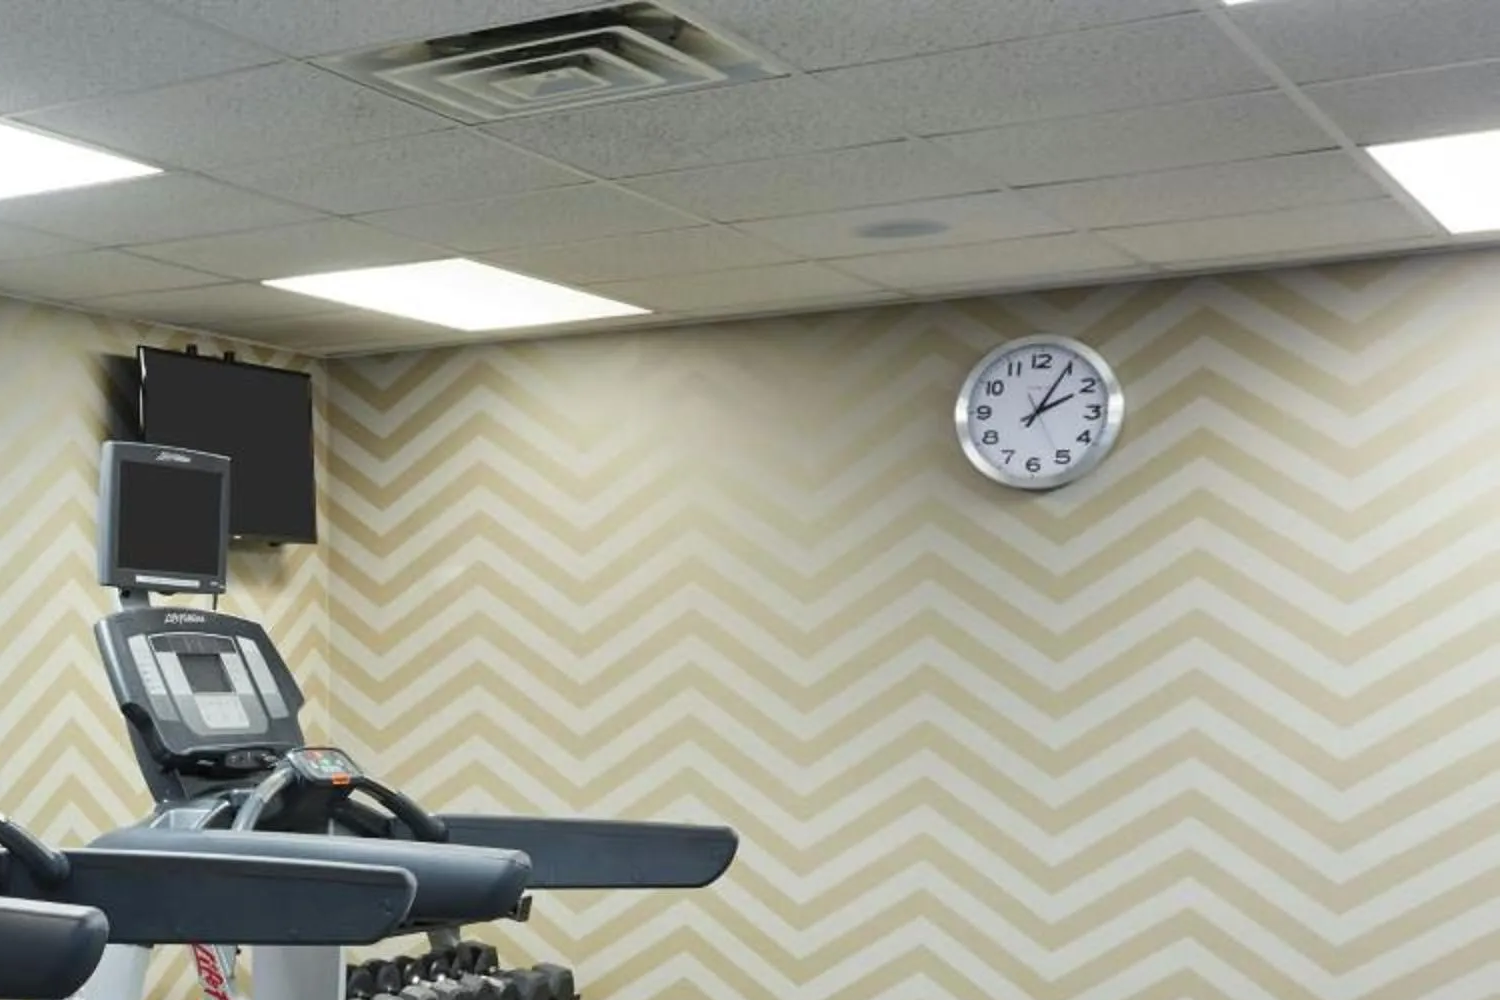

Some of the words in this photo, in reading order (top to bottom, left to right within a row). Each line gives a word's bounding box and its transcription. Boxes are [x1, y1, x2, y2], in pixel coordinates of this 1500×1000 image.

[1007, 361, 1023, 377] 11
[1031, 353, 1053, 369] 12
[985, 380, 1005, 397] 10
[1078, 377, 1097, 394] 2
[976, 405, 993, 421] 9
[1083, 404, 1101, 421] 3
[981, 429, 999, 446] 8
[1075, 429, 1092, 446] 4
[1001, 449, 1016, 465] 7
[1025, 457, 1041, 473] 6
[1054, 449, 1071, 465] 5
